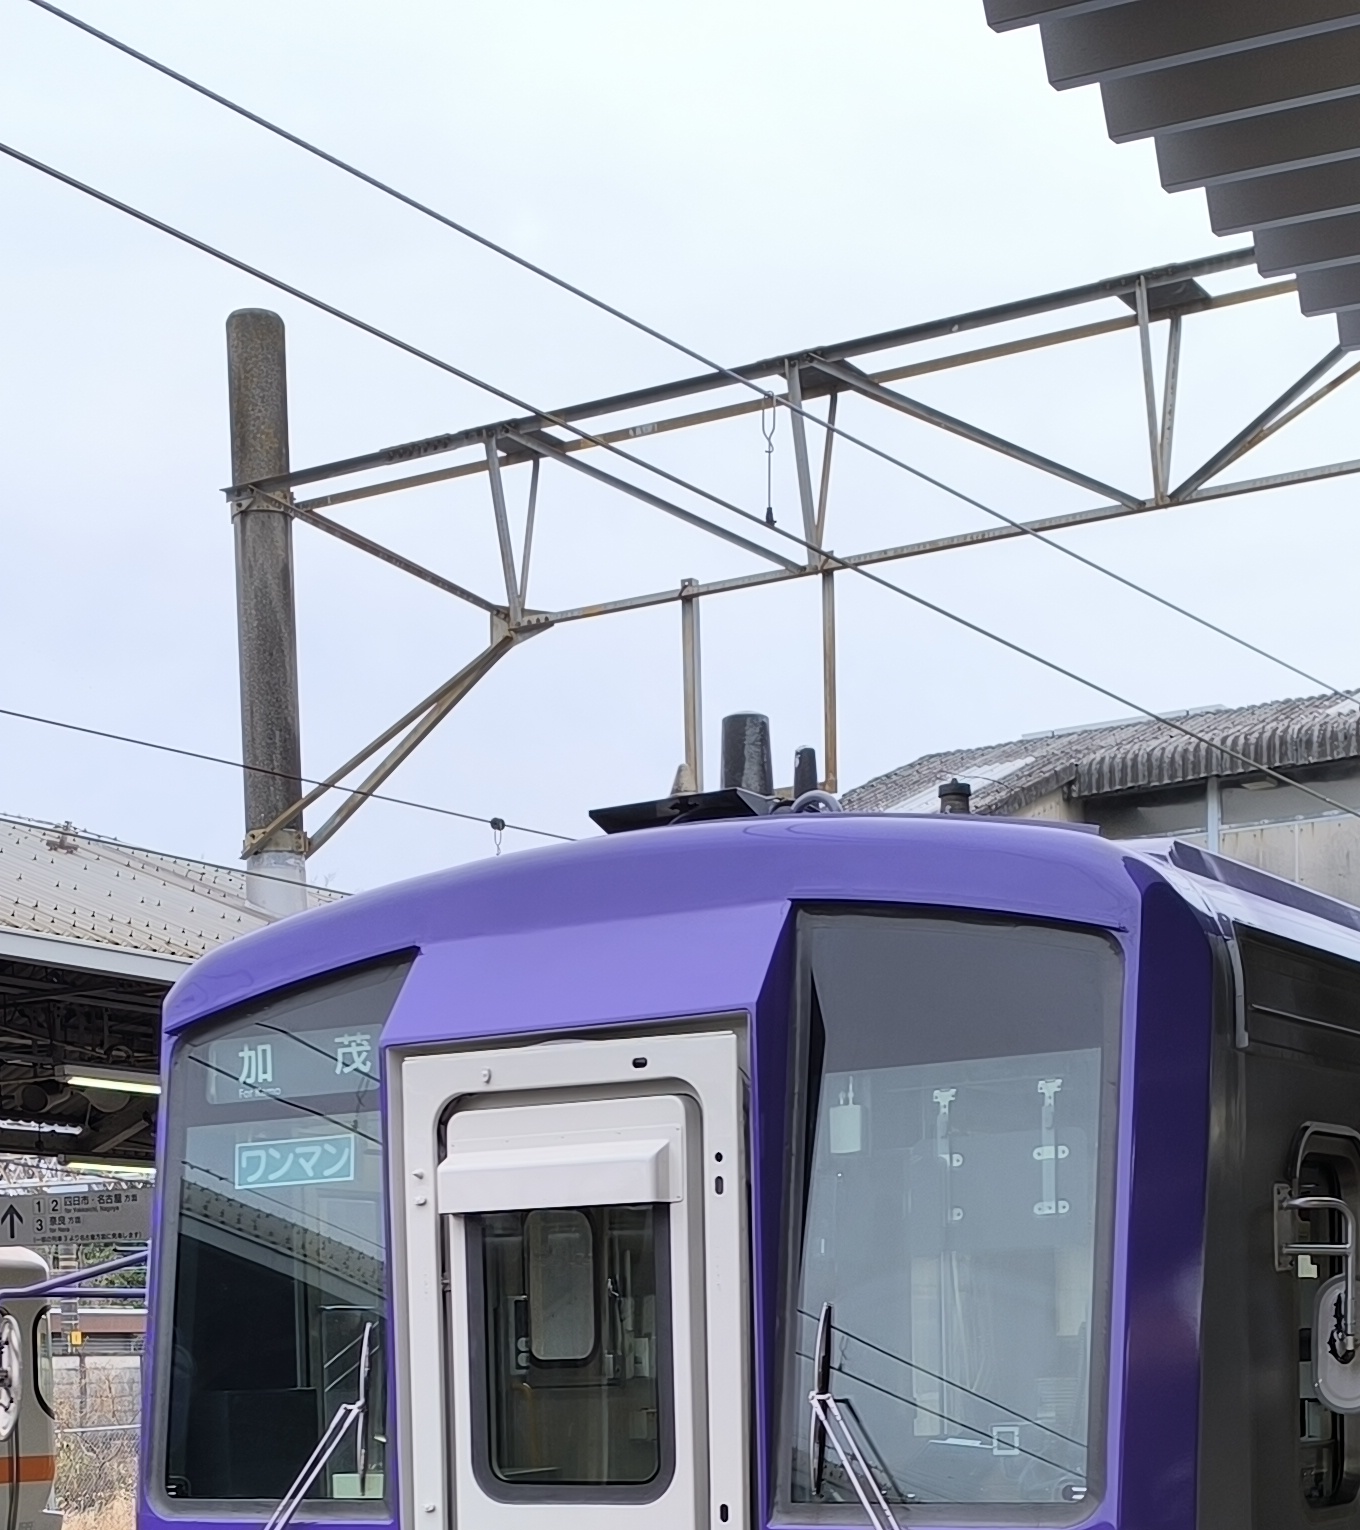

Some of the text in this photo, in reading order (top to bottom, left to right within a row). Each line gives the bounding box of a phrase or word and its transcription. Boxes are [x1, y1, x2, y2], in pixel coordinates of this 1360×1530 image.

[238, 1032, 372, 1084] 加茂
[242, 1143, 350, 1182] ワンマン
[35, 1201, 41, 1213] 1
[51, 1200, 58, 1212] 2
[35, 1219, 43, 1232] 3
